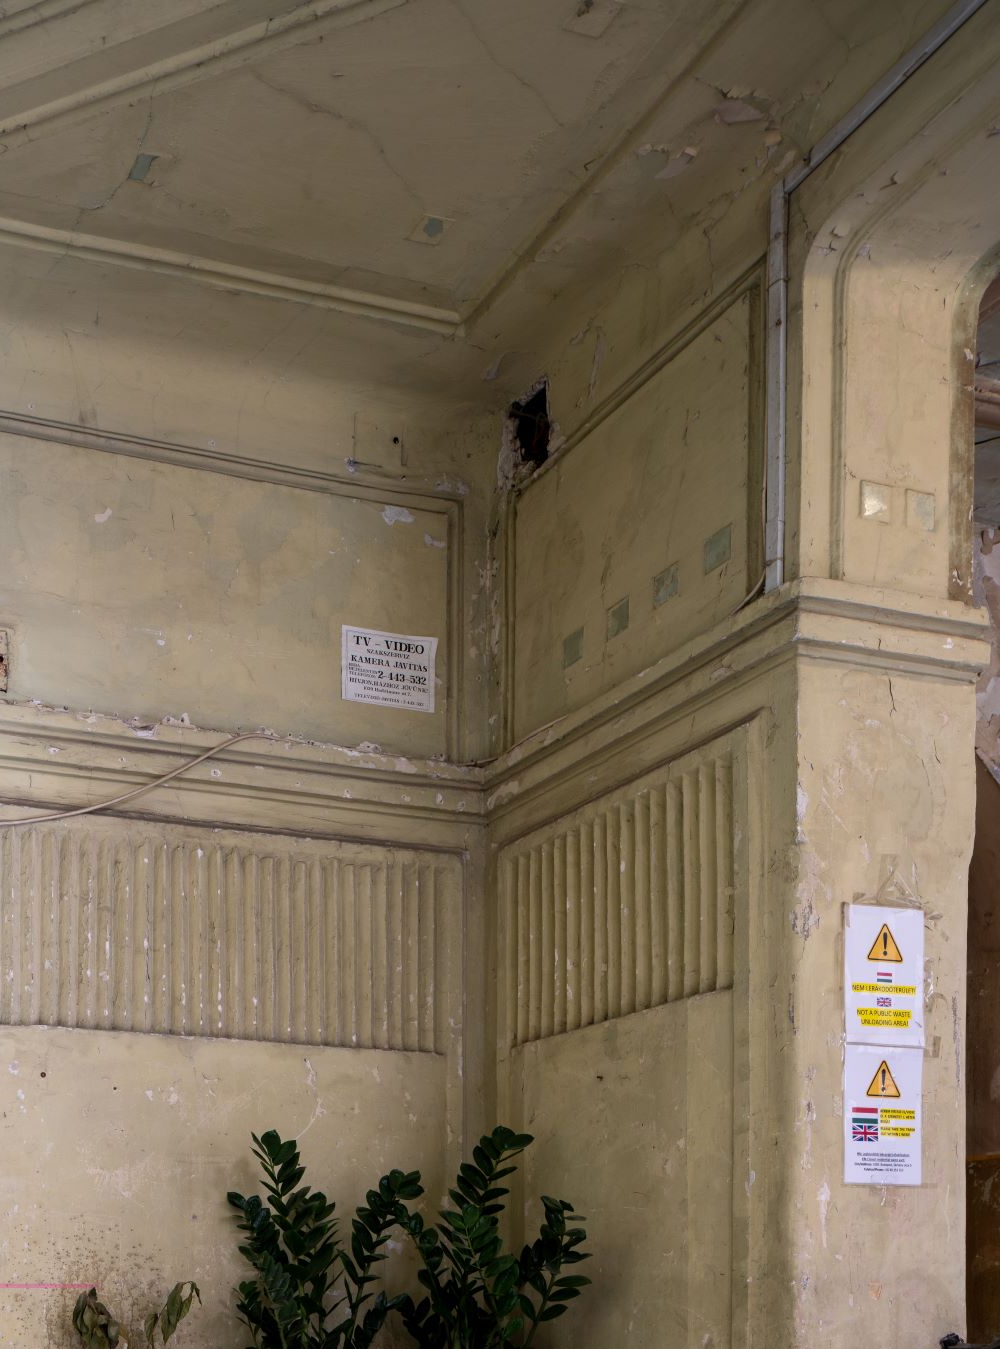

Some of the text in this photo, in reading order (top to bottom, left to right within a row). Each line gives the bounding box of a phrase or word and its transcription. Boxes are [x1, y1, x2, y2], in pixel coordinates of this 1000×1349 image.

[353, 635, 371, 646] TV
[385, 640, 424, 654] VIDEO
[367, 648, 410, 659] SZAKSZERVIZ
[351, 654, 390, 667] KAMERA
